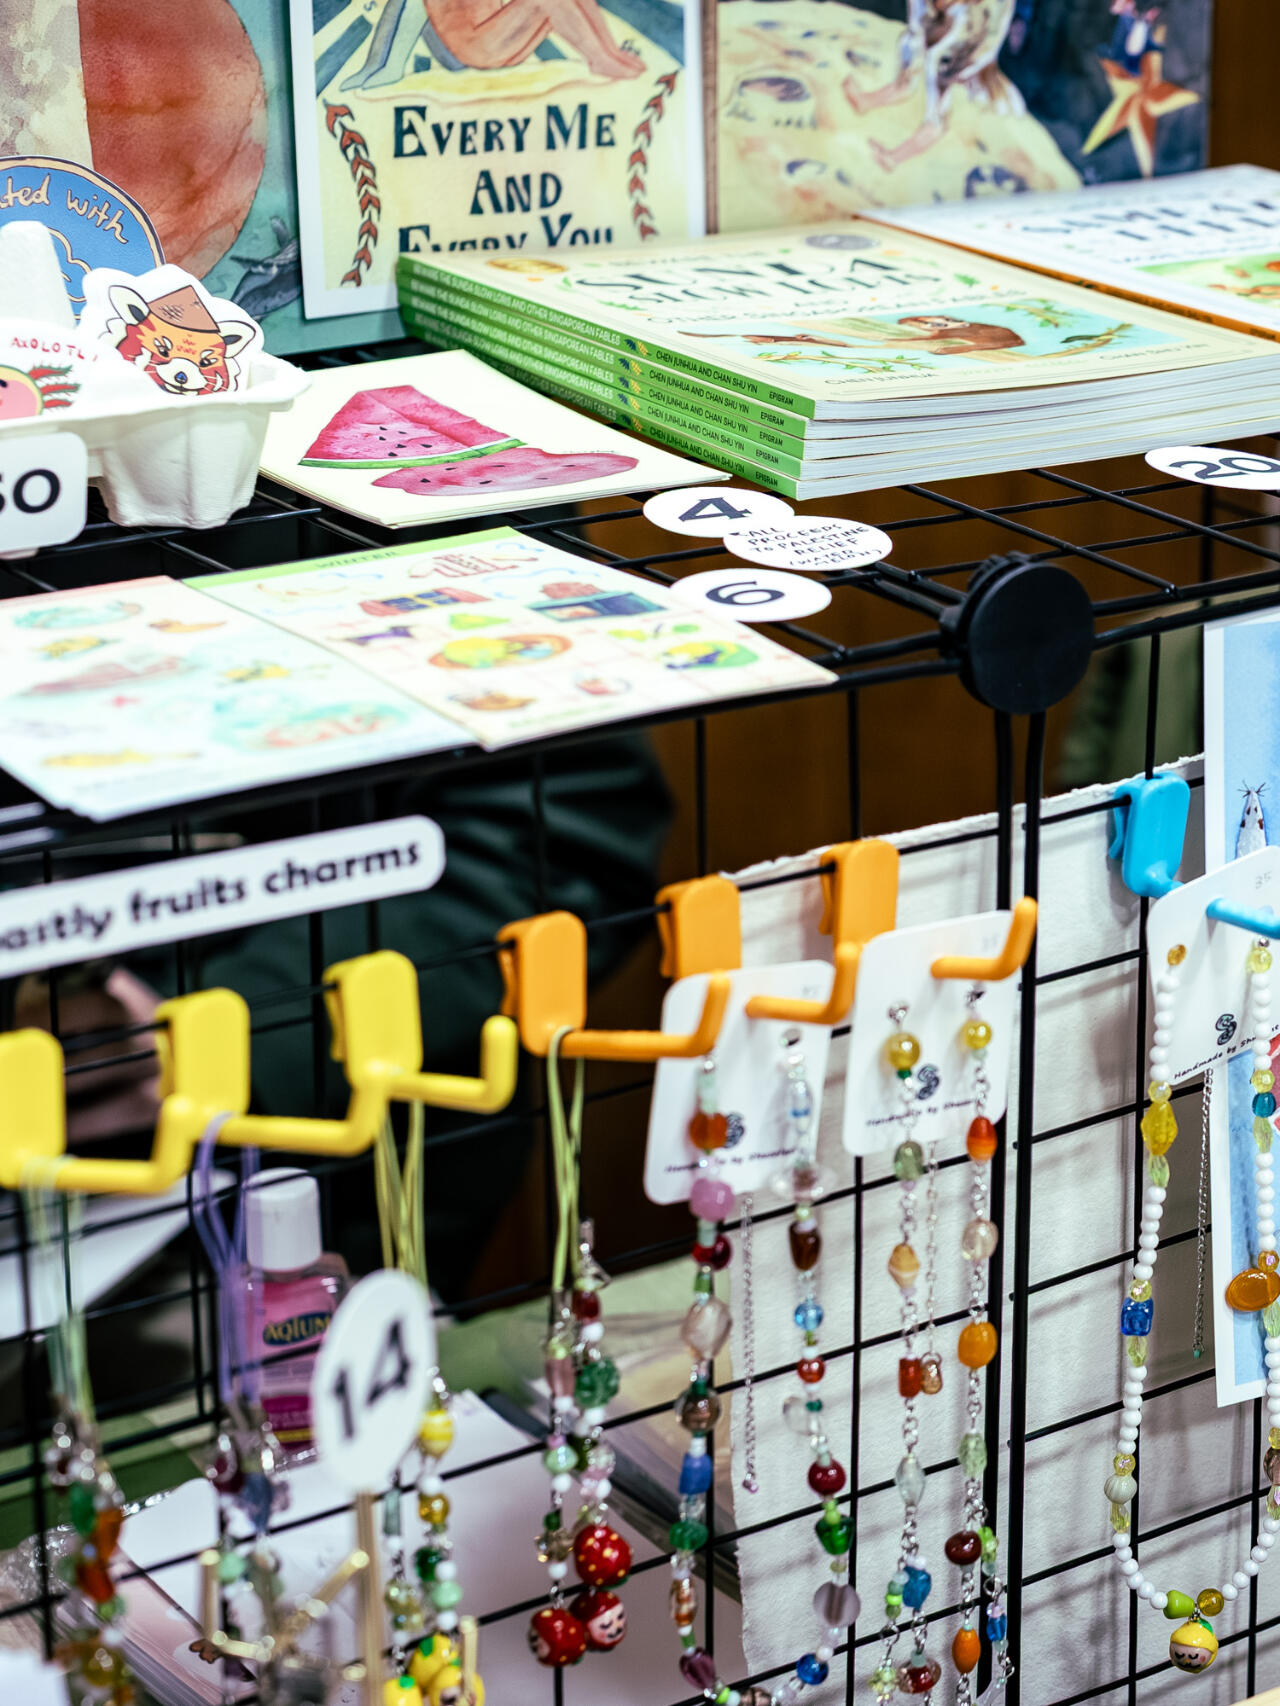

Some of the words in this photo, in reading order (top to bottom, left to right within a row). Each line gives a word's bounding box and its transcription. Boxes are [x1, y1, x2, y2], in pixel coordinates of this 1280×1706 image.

[0, 173, 50, 208] ted
[66, 189, 129, 244] with
[470, 170, 562, 215] AND
[590, 347, 614, 365] FABLES
[650, 369, 666, 382] CHEN
[666, 374, 690, 392] JUNHUA
[691, 383, 704, 396] AND
[705, 389, 722, 403] CHAN
[724, 396, 737, 409] SHU
[738, 401, 749, 413] YIN
[760, 411, 785, 427] EPIGRAM
[596, 327, 621, 346] FABLES
[656, 350, 673, 364] CHEN
[673, 355, 697, 372] JUNHUA
[698, 364, 712, 377] AND
[713, 370, 730, 384] CHAN
[732, 376, 746, 390] SHU
[746, 381, 757, 393] YIN
[769, 391, 794, 406] EPIGRAM
[589, 381, 613, 399] FABLES
[648, 406, 663, 419] CHEN
[664, 411, 687, 429] JUNHUA
[688, 420, 701, 433] AND
[702, 426, 719, 440] CHAN
[720, 434, 733, 447] SHU
[734, 439, 745, 451] YIN
[755, 449, 779, 464] EPIGRAM
[590, 365, 614, 383] FABLES
[649, 389, 665, 403] CHEN
[666, 394, 689, 412] JUNHUA
[690, 403, 704, 416] AND
[704, 408, 721, 423] CHAN
[723, 415, 736, 429] SHU
[737, 421, 748, 433] YIN
[759, 431, 783, 447] EPIGRAM
[651, 427, 666, 440] CHEN
[666, 432, 688, 450] JUNHUA
[689, 442, 702, 456] AND
[703, 448, 720, 462] CHAN
[721, 456, 734, 470] SHU
[734, 462, 745, 474] YIN
[755, 471, 778, 487] EPIGRAM
[678, 497, 753, 522] 4
[749, 527, 783, 537] ALL
[748, 523, 842, 546] PROCEEDS
[778, 526, 869, 549] PALESTINE
[794, 537, 858, 555] RELIEF
[705, 581, 785, 606] 6
[129, 878, 247, 926] fruits
[264, 841, 421, 895] charms
[1174, 1051, 1223, 1079] Handmade
[265, 1316, 331, 1342] AQIUM
[334, 1320, 410, 1437] 14
